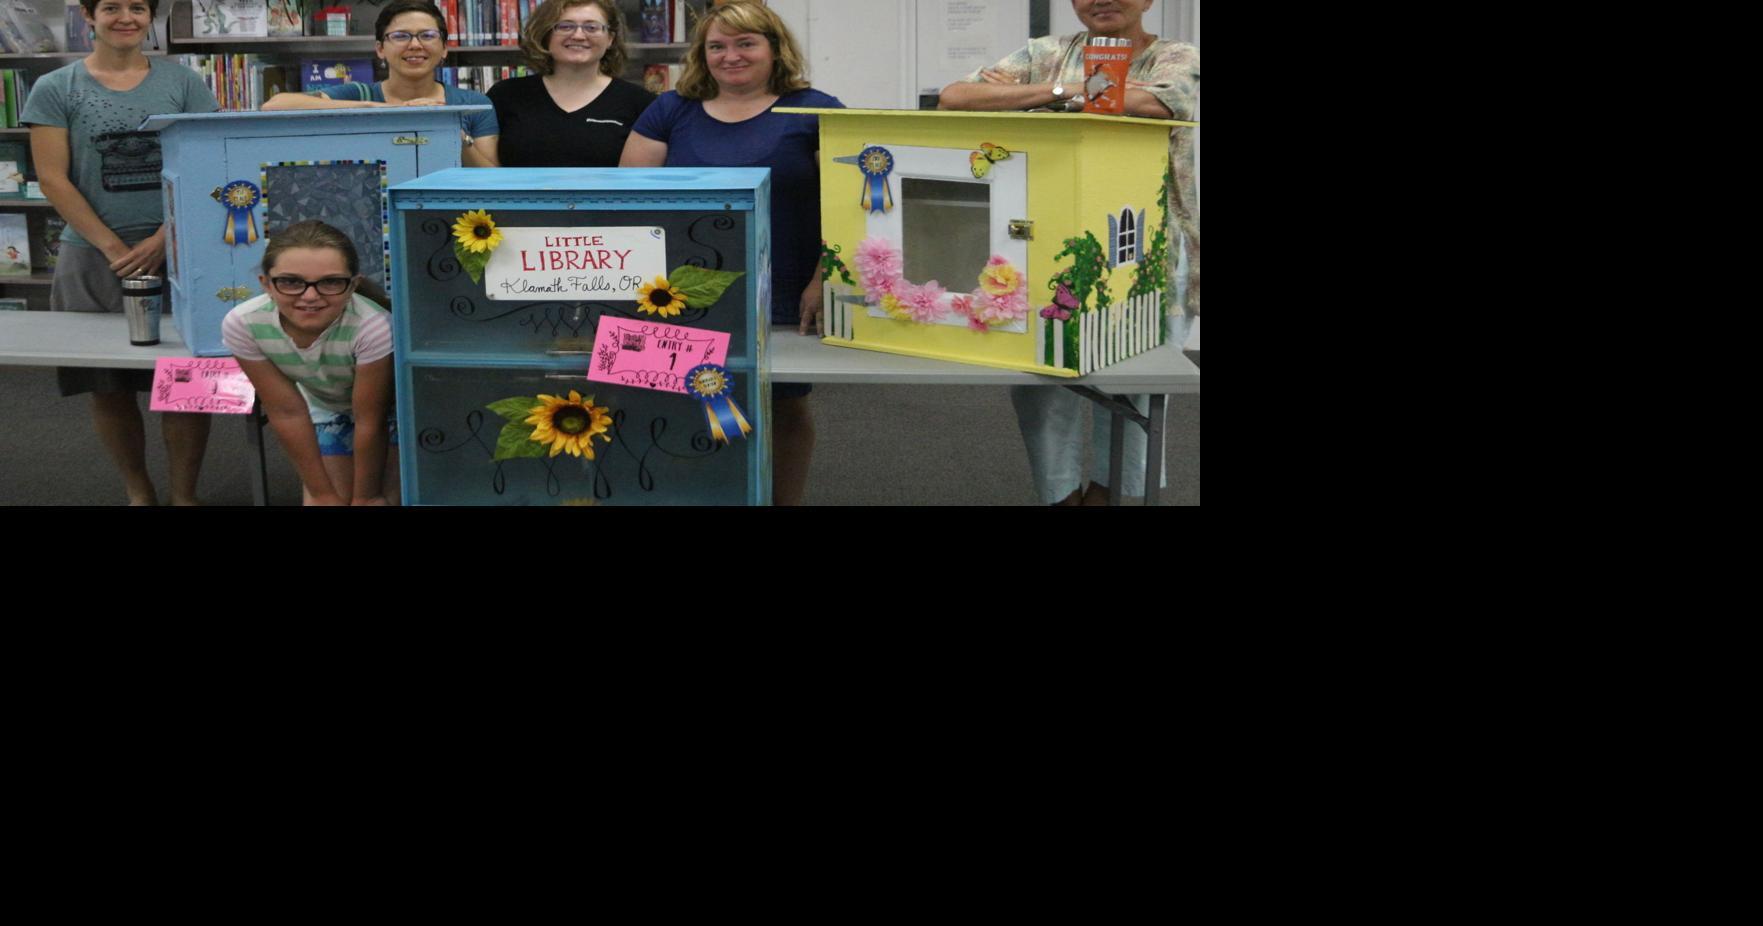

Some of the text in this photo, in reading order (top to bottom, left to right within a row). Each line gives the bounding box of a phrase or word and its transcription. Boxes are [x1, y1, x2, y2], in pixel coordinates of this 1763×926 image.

[545, 236, 604, 247] LITTLE
[520, 249, 632, 271] LIBRARY
[500, 275, 642, 294] Klamath Falls, OR
[656, 340, 683, 352] ENTRY
[669, 352, 677, 371] 1
